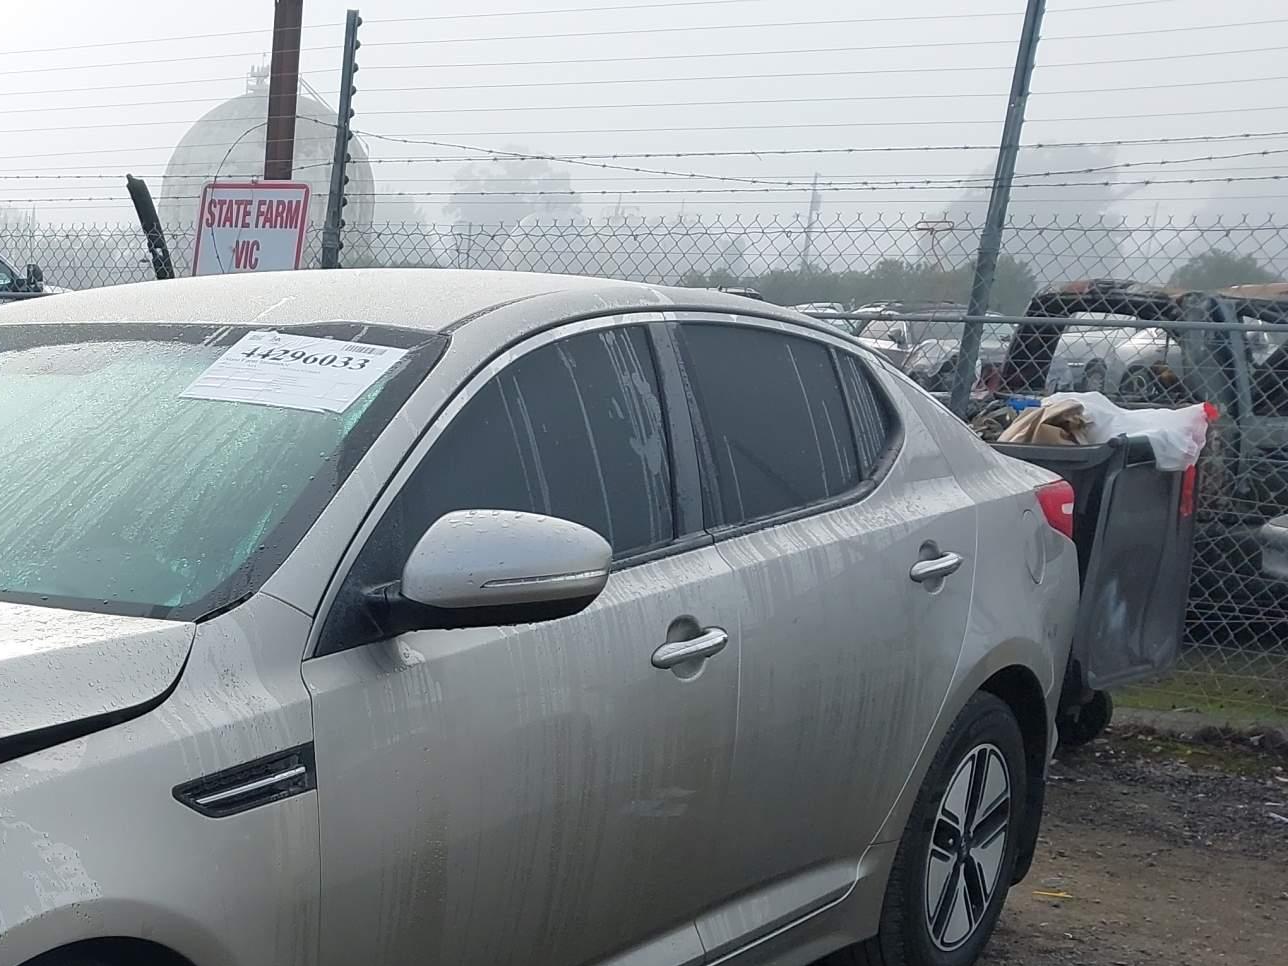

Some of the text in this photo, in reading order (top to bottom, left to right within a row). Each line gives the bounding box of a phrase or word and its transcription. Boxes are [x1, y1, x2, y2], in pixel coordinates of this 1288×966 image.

[205, 199, 302, 229] STATE FARM
[234, 240, 260, 270] VIC
[241, 346, 370, 371] 44296033
